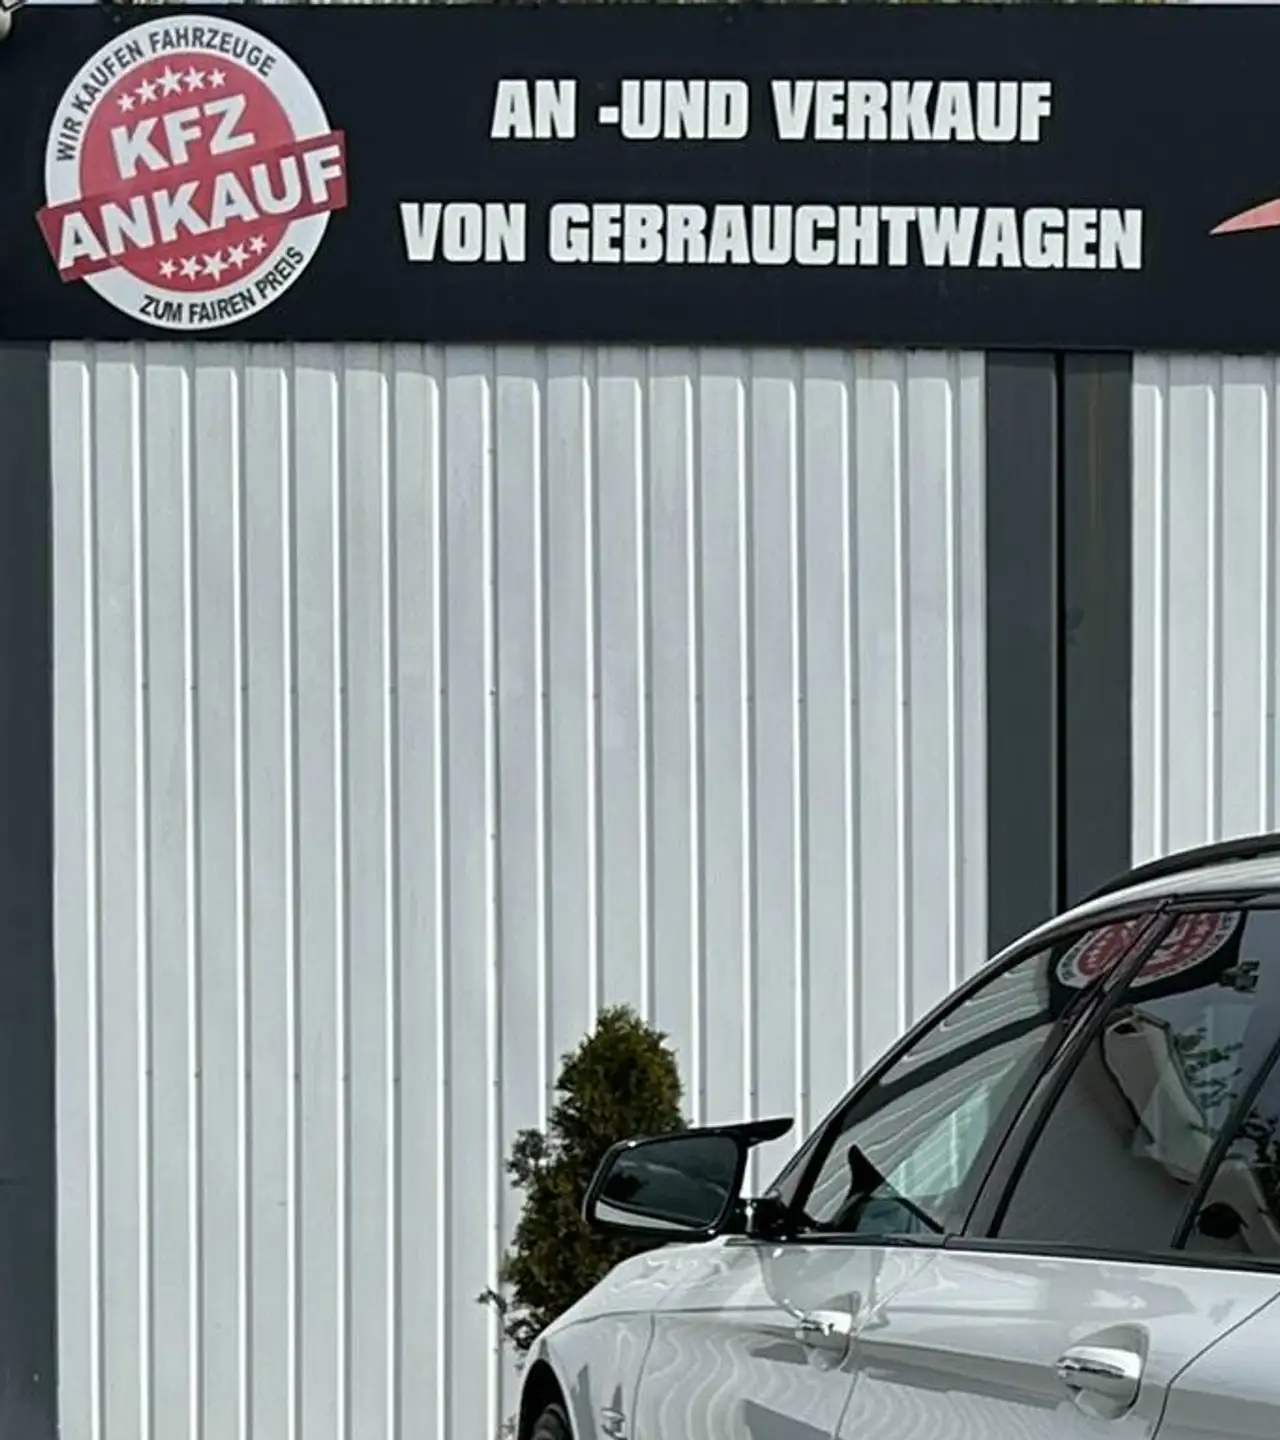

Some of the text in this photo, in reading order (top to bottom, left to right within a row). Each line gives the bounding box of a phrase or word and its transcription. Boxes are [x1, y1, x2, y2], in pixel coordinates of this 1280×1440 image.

[56, 26, 277, 163] WIR KAUFEN FAHRZEUGE
[490, 79, 577, 139] AN
[771, 80, 1052, 142] VERKAUF
[110, 93, 256, 181] KFZ
[58, 144, 343, 269] ANKAUF
[400, 202, 1144, 270] VON GEBRAUCHTWAGEN
[139, 246, 304, 324] ZUM FAIREN PREIS
